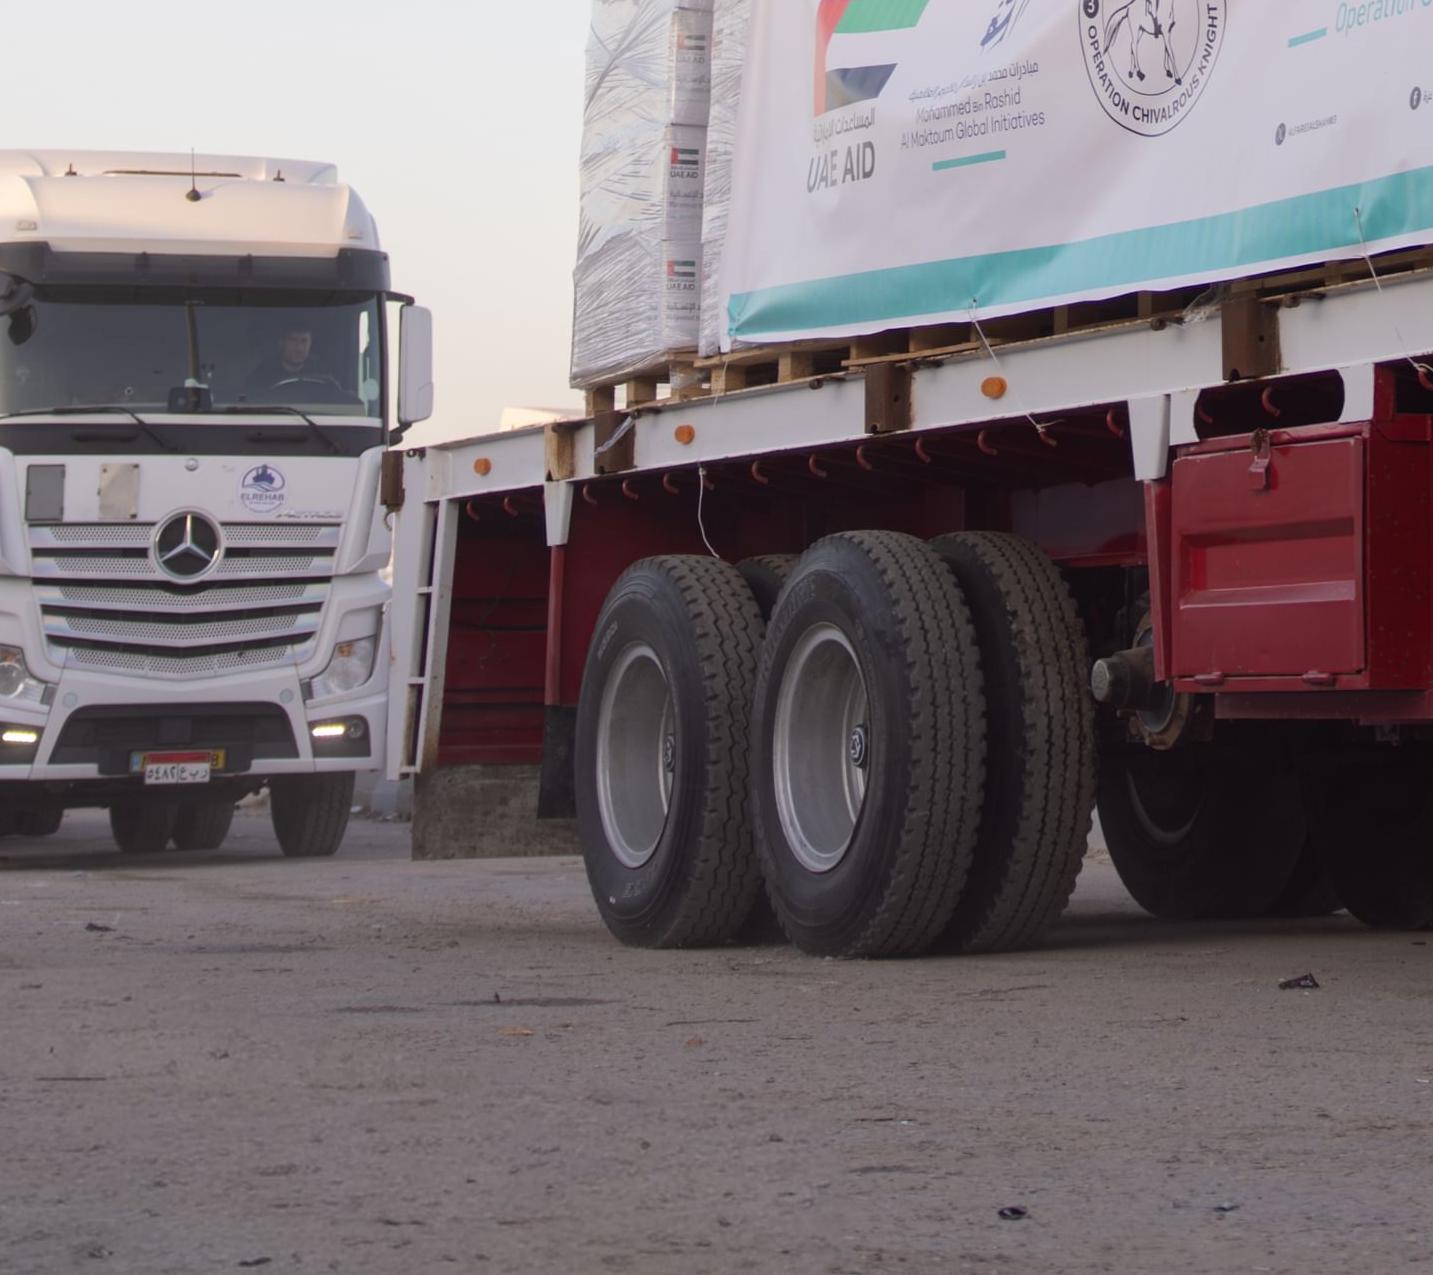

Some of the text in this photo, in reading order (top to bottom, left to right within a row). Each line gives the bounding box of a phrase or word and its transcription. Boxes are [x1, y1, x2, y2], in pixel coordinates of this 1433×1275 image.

[1088, 3, 1218, 124] OPERATION CHIVALROUS KNIGHT
[984, 87, 1022, 110] Rashid
[911, 126, 954, 149] Maktoum
[956, 115, 989, 140] Global
[991, 110, 1046, 134] Initiatives
[806, 140, 876, 194] UAE AID
